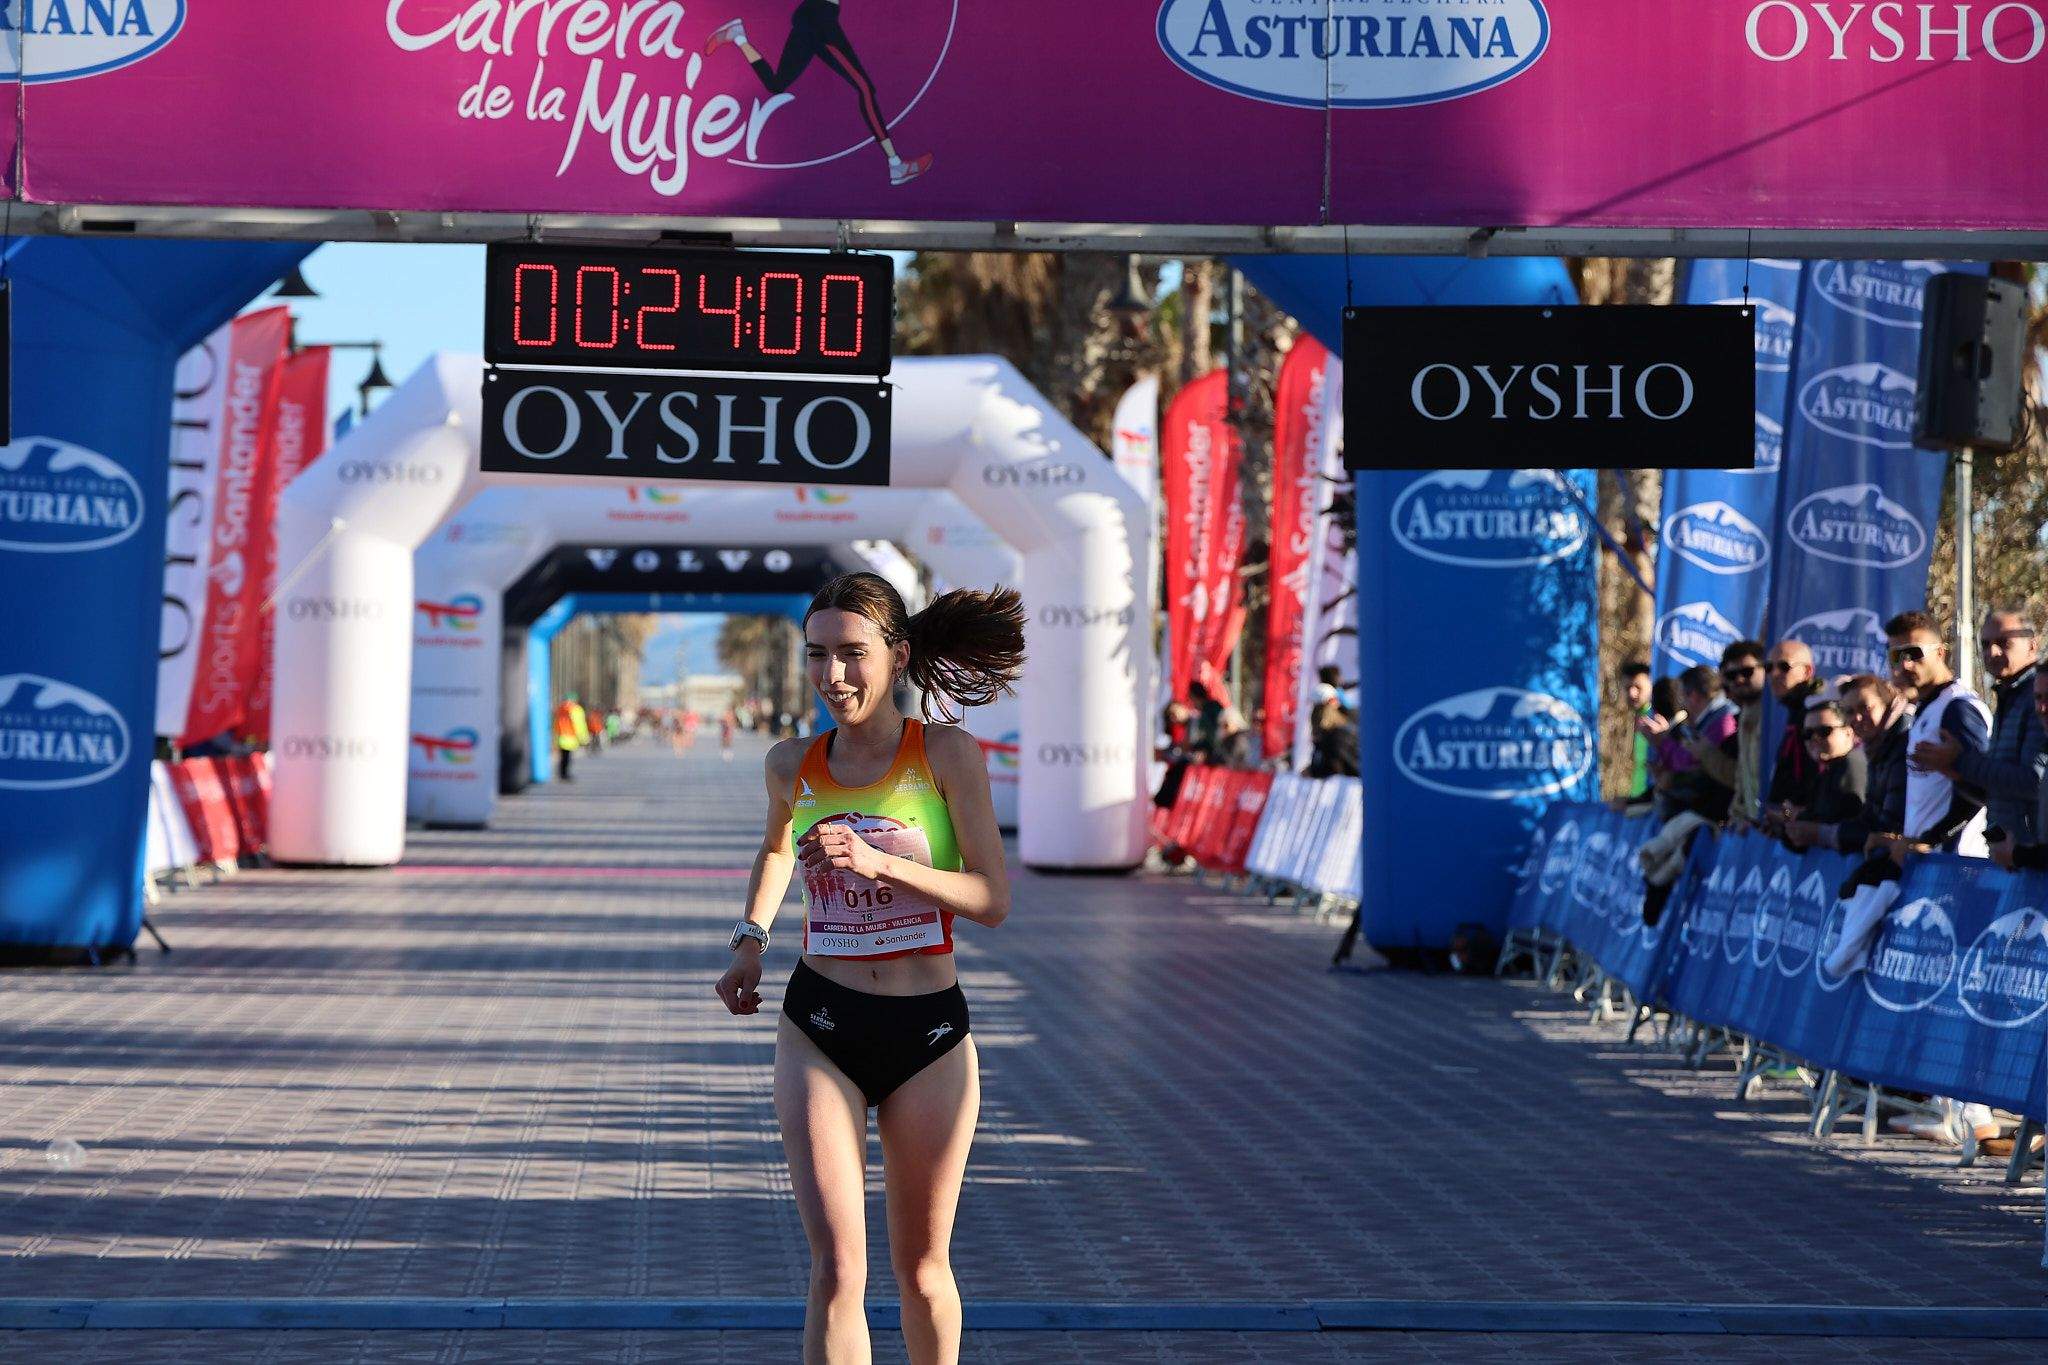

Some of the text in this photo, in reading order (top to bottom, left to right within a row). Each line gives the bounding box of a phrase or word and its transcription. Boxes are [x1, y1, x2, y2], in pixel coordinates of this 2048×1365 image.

[385, 0, 685, 58] Carrera
[1187, 0, 1519, 59] ASTURIANA
[1745, 0, 2046, 64] OYSHO
[457, 52, 796, 197] de la Mujer
[514, 263, 864, 357] 00:24:00
[1411, 362, 1694, 421] OYSHO
[214, 360, 263, 548] Santander
[503, 384, 872, 471] OYSHO
[338, 460, 442, 485] OYSHO
[1291, 366, 1326, 554] Santander
[585, 547, 793, 574] VOLVO
[823, 924, 848, 932] CARRERA
[865, 923, 887, 932] MUJER
[892, 917, 922, 927] VALENCIA
[845, 886, 894, 909] 016
[861, 913, 873, 922] 18
[822, 932, 926, 948] OYSHO Santander
